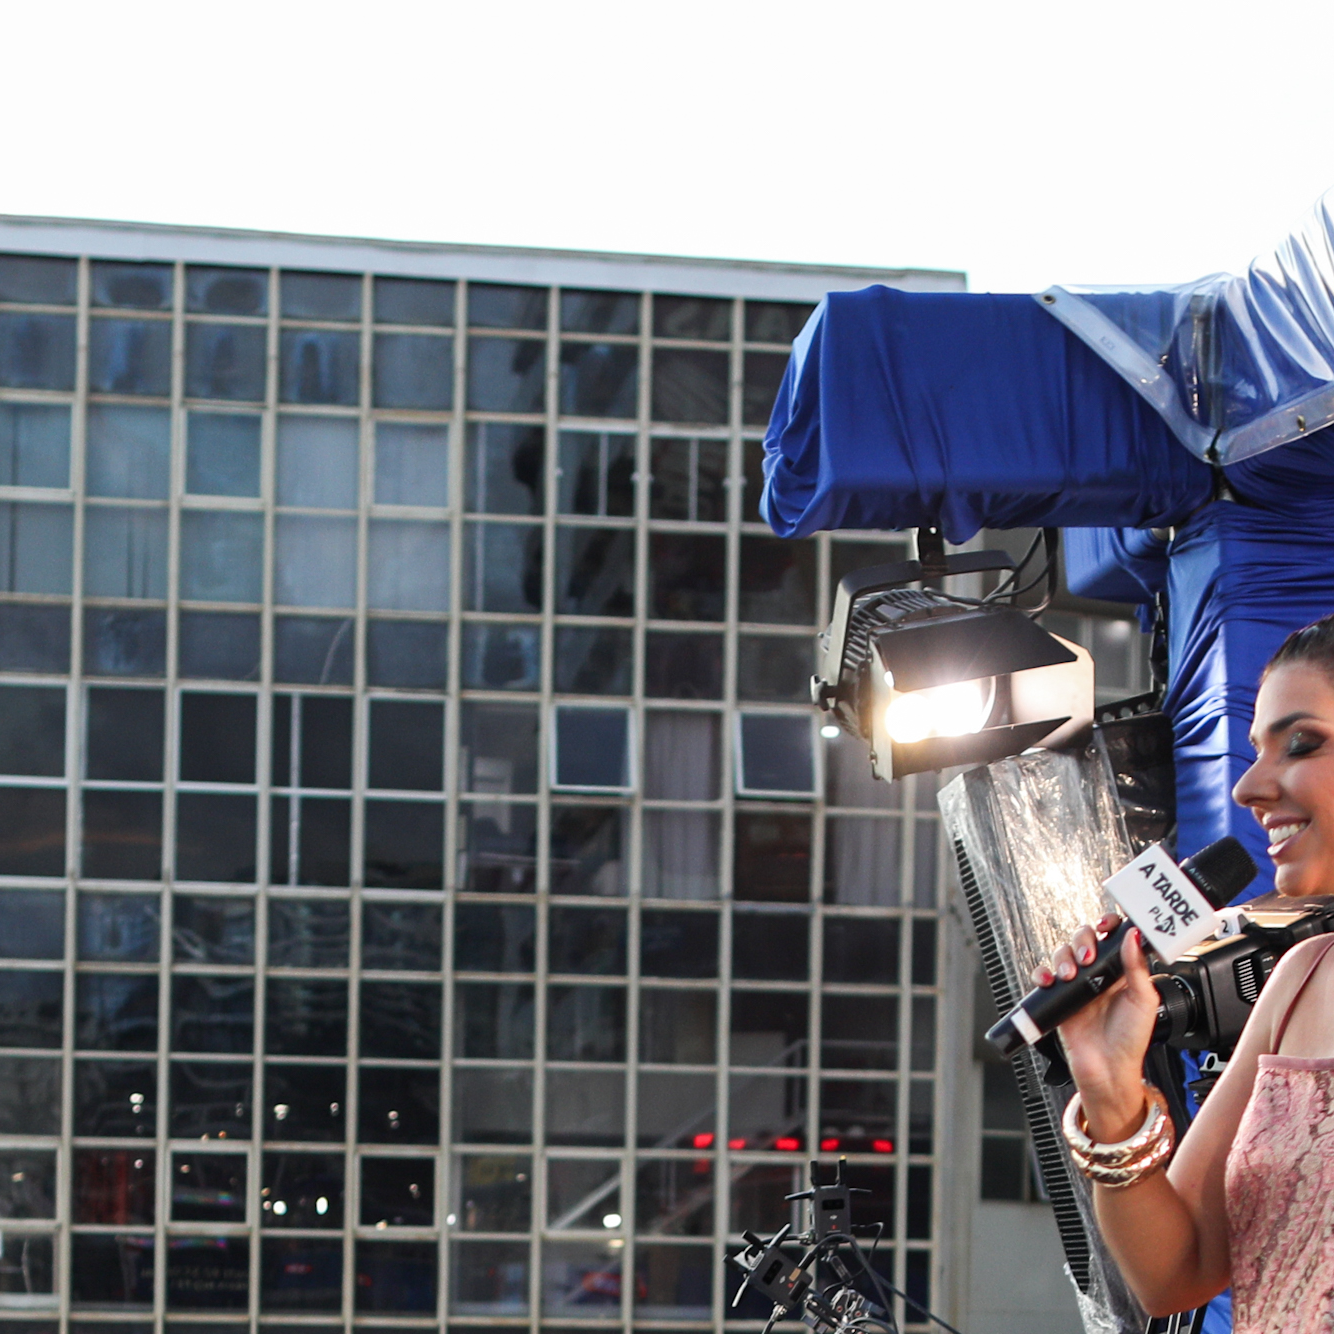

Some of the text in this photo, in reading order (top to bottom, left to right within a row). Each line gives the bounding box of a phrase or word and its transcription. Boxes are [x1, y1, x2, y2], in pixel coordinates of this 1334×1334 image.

[1138, 862, 1200, 927] A TARDE
[1221, 919, 1229, 934] 2
